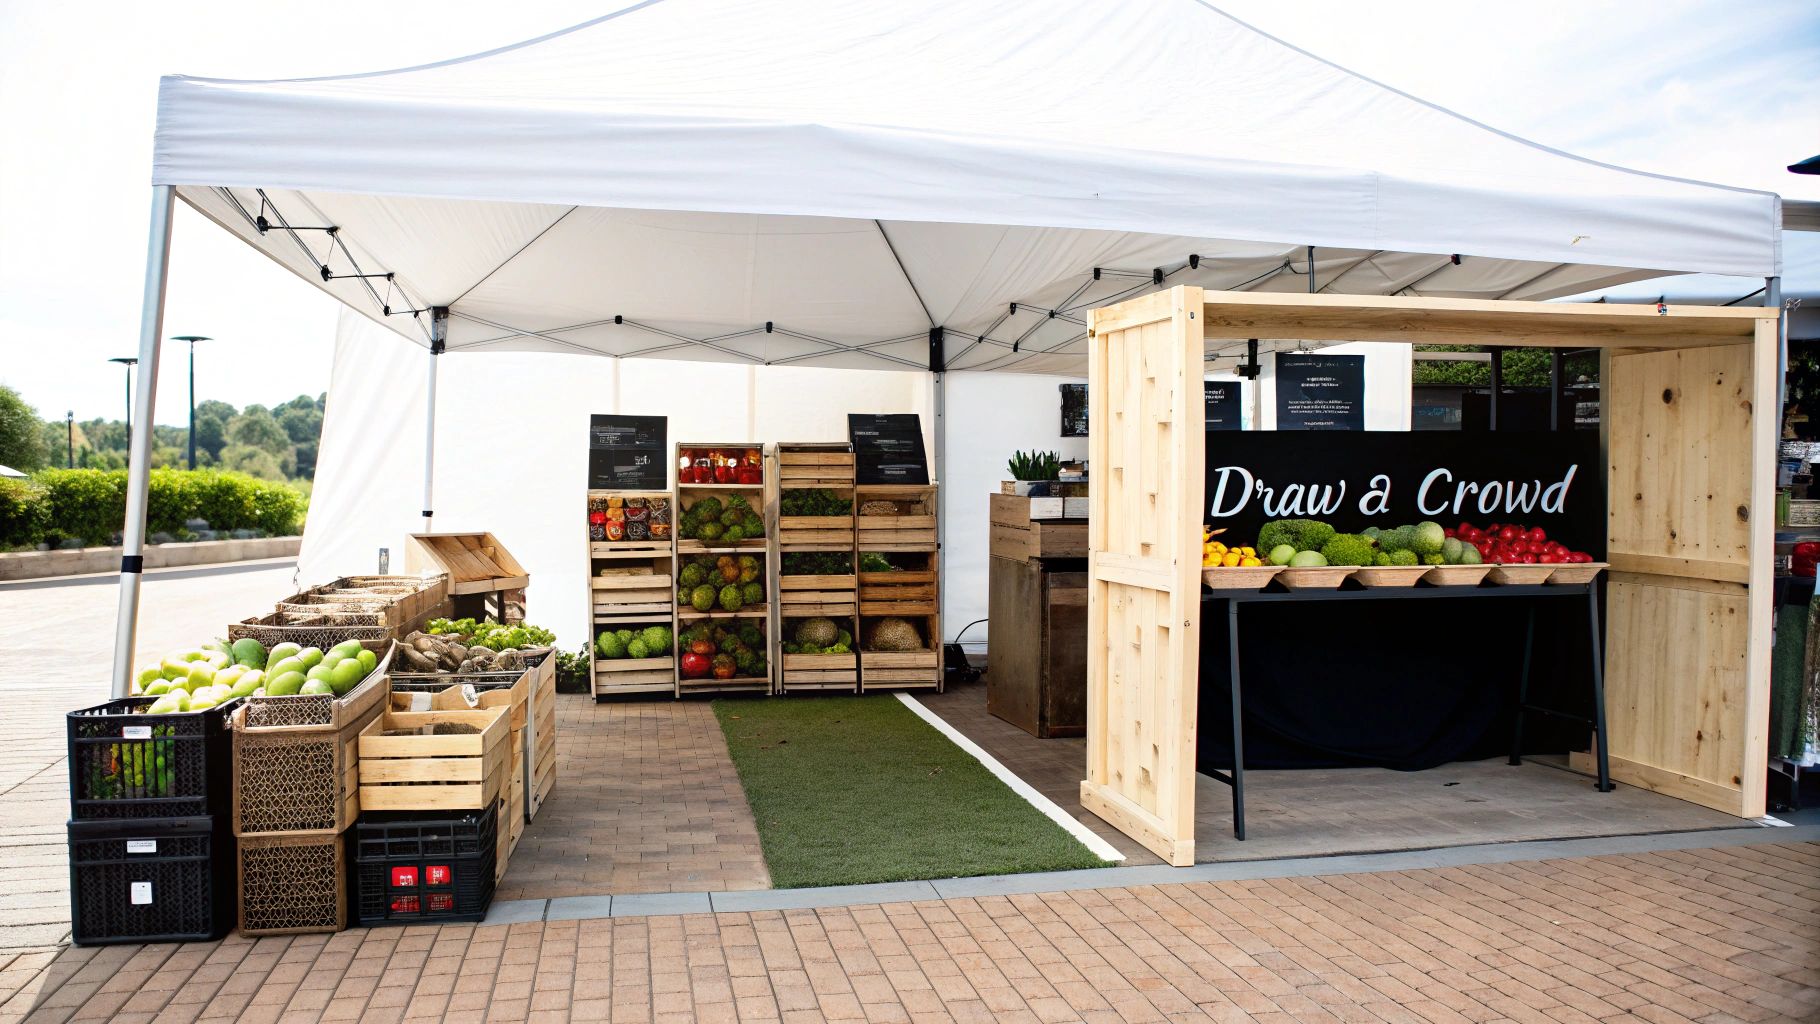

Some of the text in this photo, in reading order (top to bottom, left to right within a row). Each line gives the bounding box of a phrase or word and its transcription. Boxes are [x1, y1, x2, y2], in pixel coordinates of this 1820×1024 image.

[1210, 464, 1578, 518] Draw a Crowd
